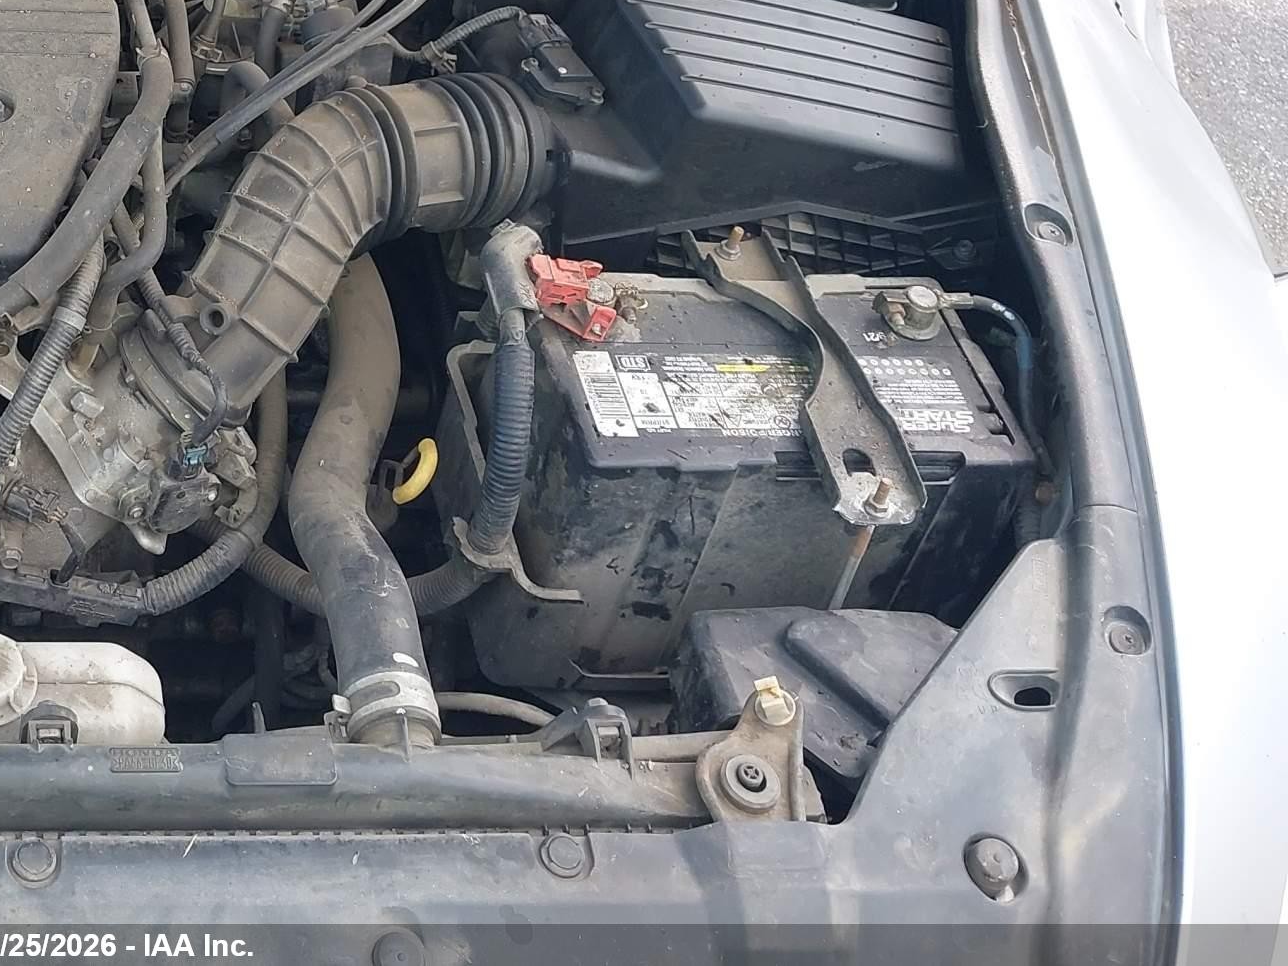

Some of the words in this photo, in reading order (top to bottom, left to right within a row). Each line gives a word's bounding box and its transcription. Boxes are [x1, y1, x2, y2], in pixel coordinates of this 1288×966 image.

[620, 357, 646, 368] STD
[897, 408, 974, 423] START
[901, 420, 971, 433] SUPER
